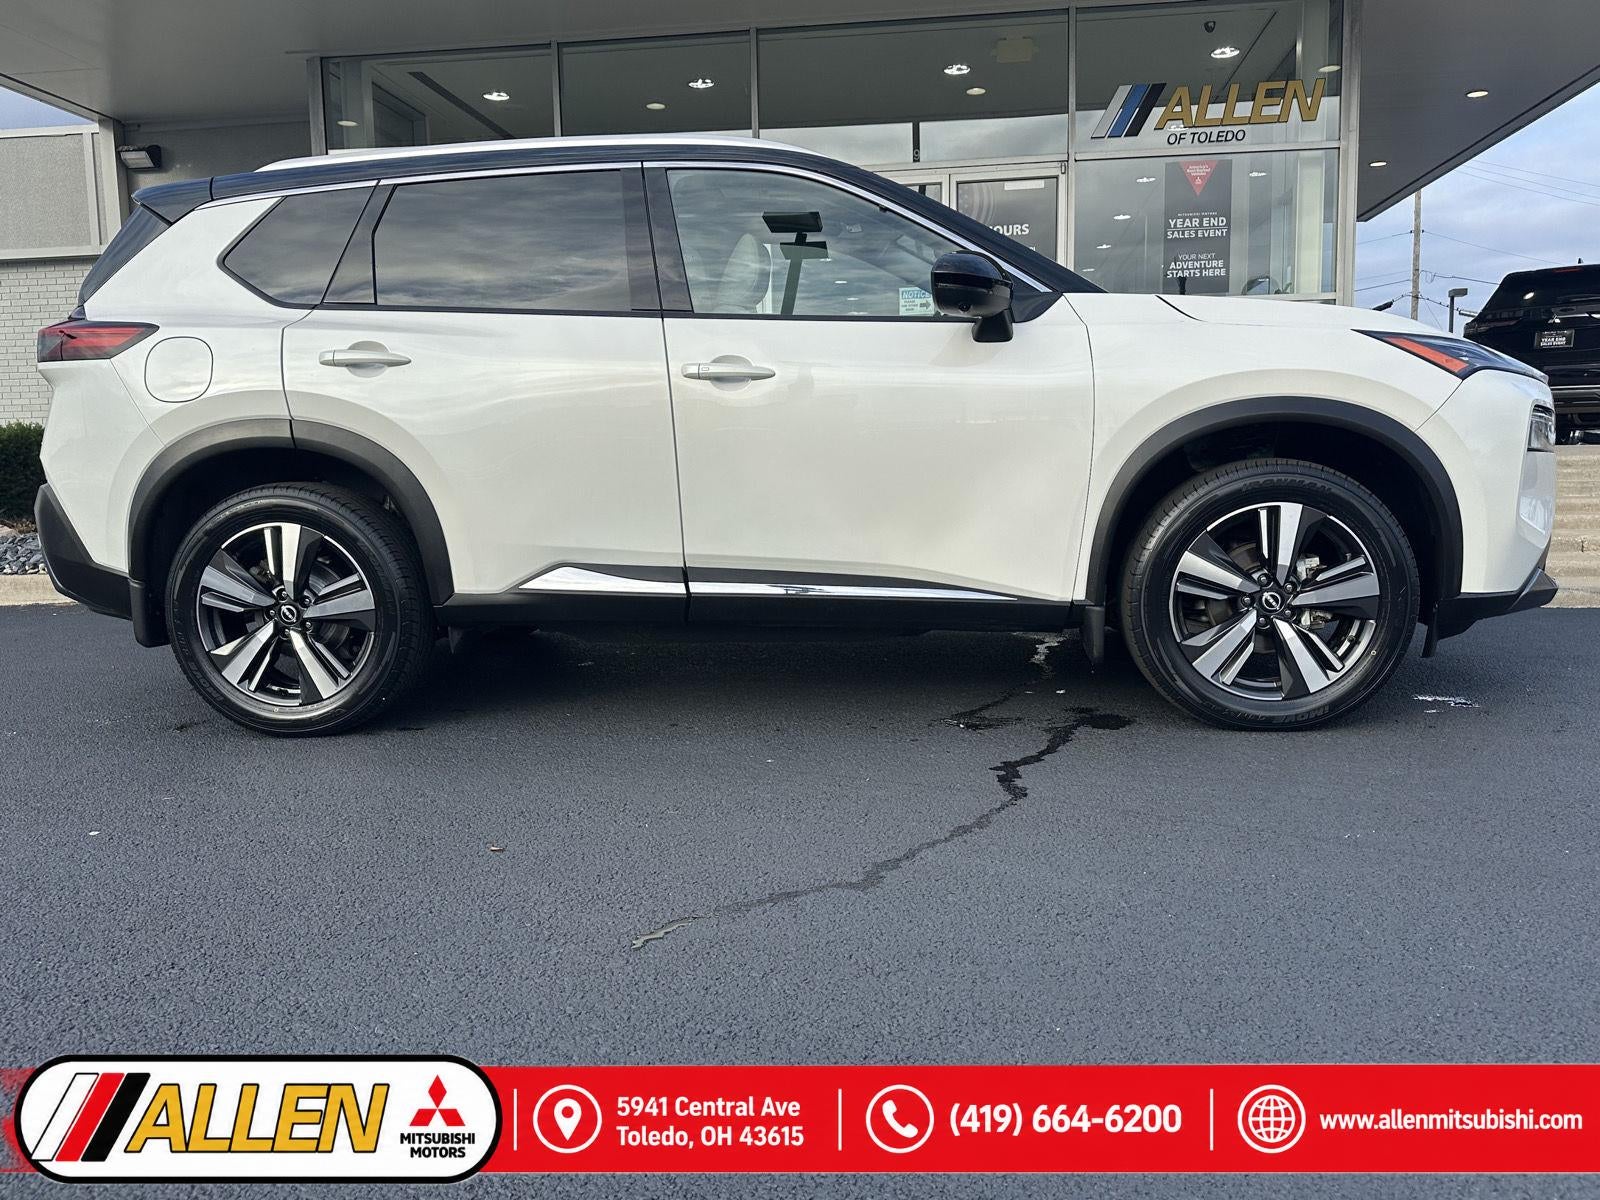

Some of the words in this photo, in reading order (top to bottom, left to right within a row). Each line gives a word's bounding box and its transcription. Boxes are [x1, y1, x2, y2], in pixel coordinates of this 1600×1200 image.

[1154, 78, 1326, 130] ALLEN
[1167, 132, 1186, 146] OF
[1189, 129, 1246, 144] TOLEDO
[1168, 218, 1200, 228] YEAR
[1203, 217, 1227, 226] END
[1167, 230, 1195, 239] SALES
[1198, 229, 1228, 238] EVENT
[1170, 260, 1224, 269] ADVENTURE
[1166, 269, 1200, 278] STARTS
[1202, 268, 1226, 277] HERE
